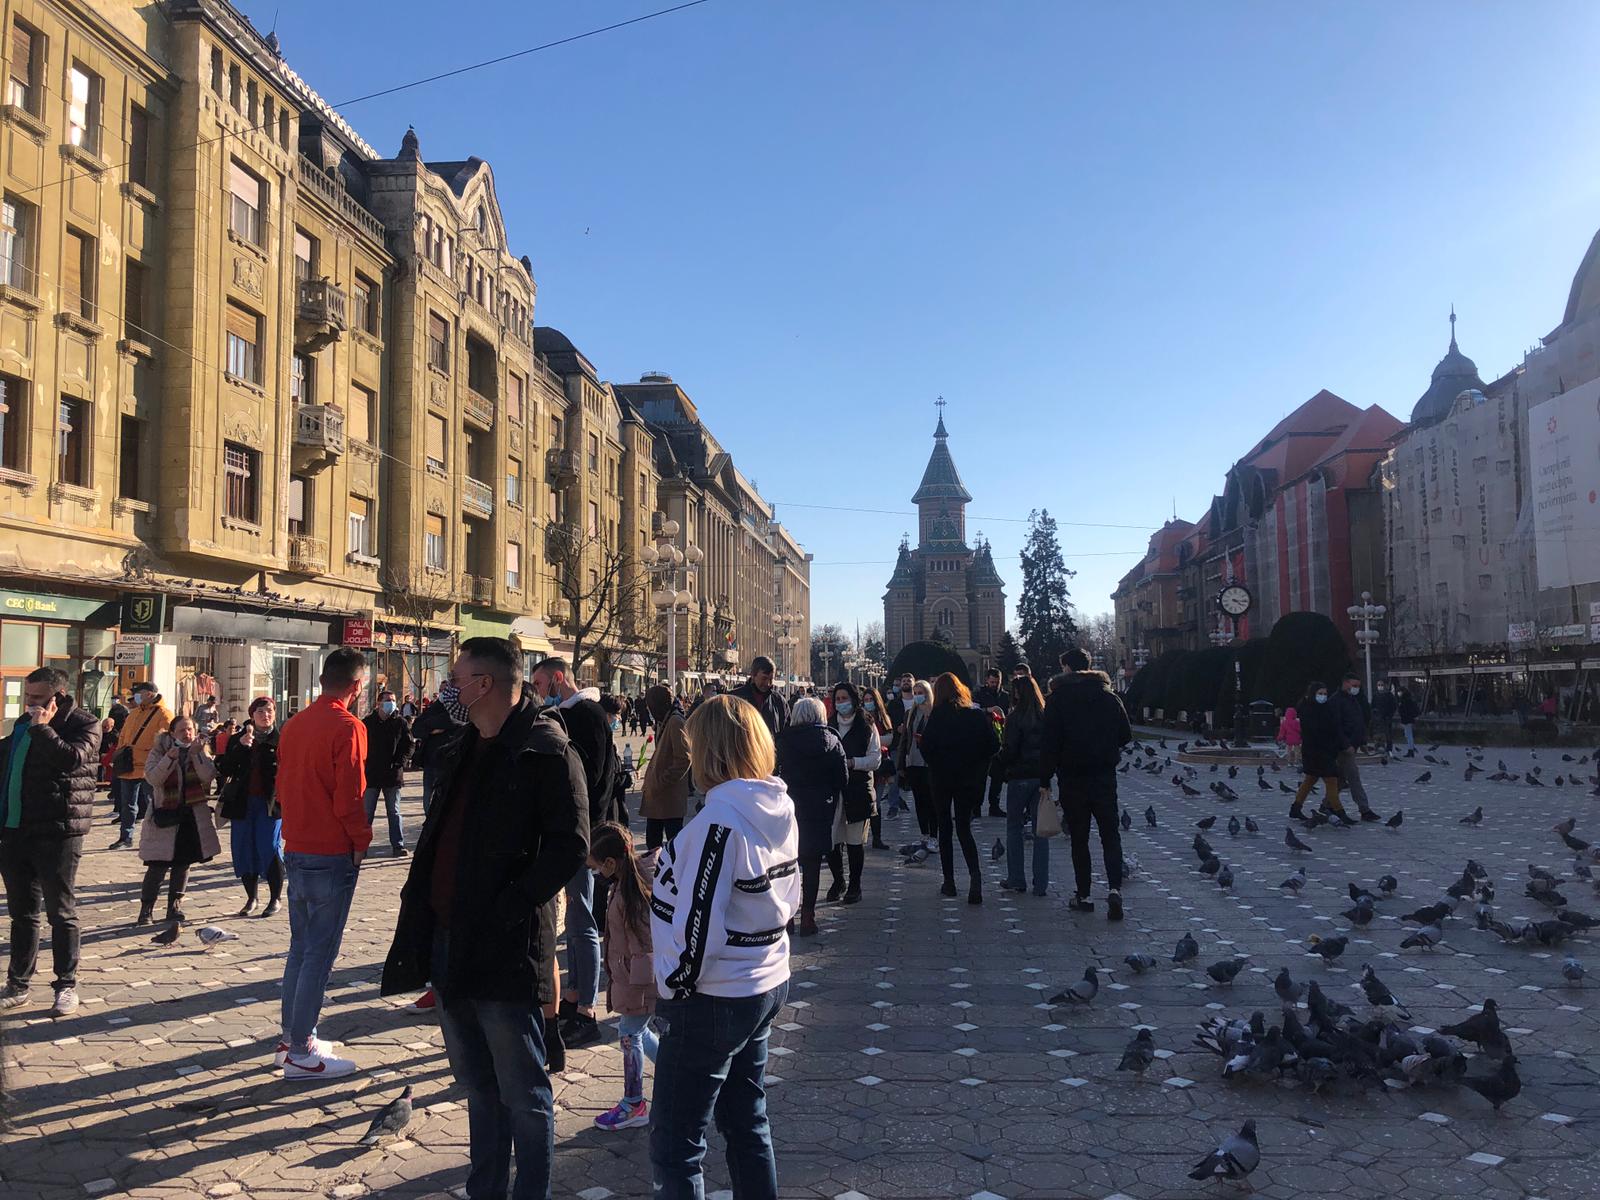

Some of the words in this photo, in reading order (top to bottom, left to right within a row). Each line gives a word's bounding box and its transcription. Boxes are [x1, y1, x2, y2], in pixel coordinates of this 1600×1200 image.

[5, 597, 25, 609] CEC
[35, 600, 57, 612] Bank
[698, 851, 717, 901] TOUGH
[737, 879, 767, 889] TOUGH
[690, 909, 702, 959] TOUGH
